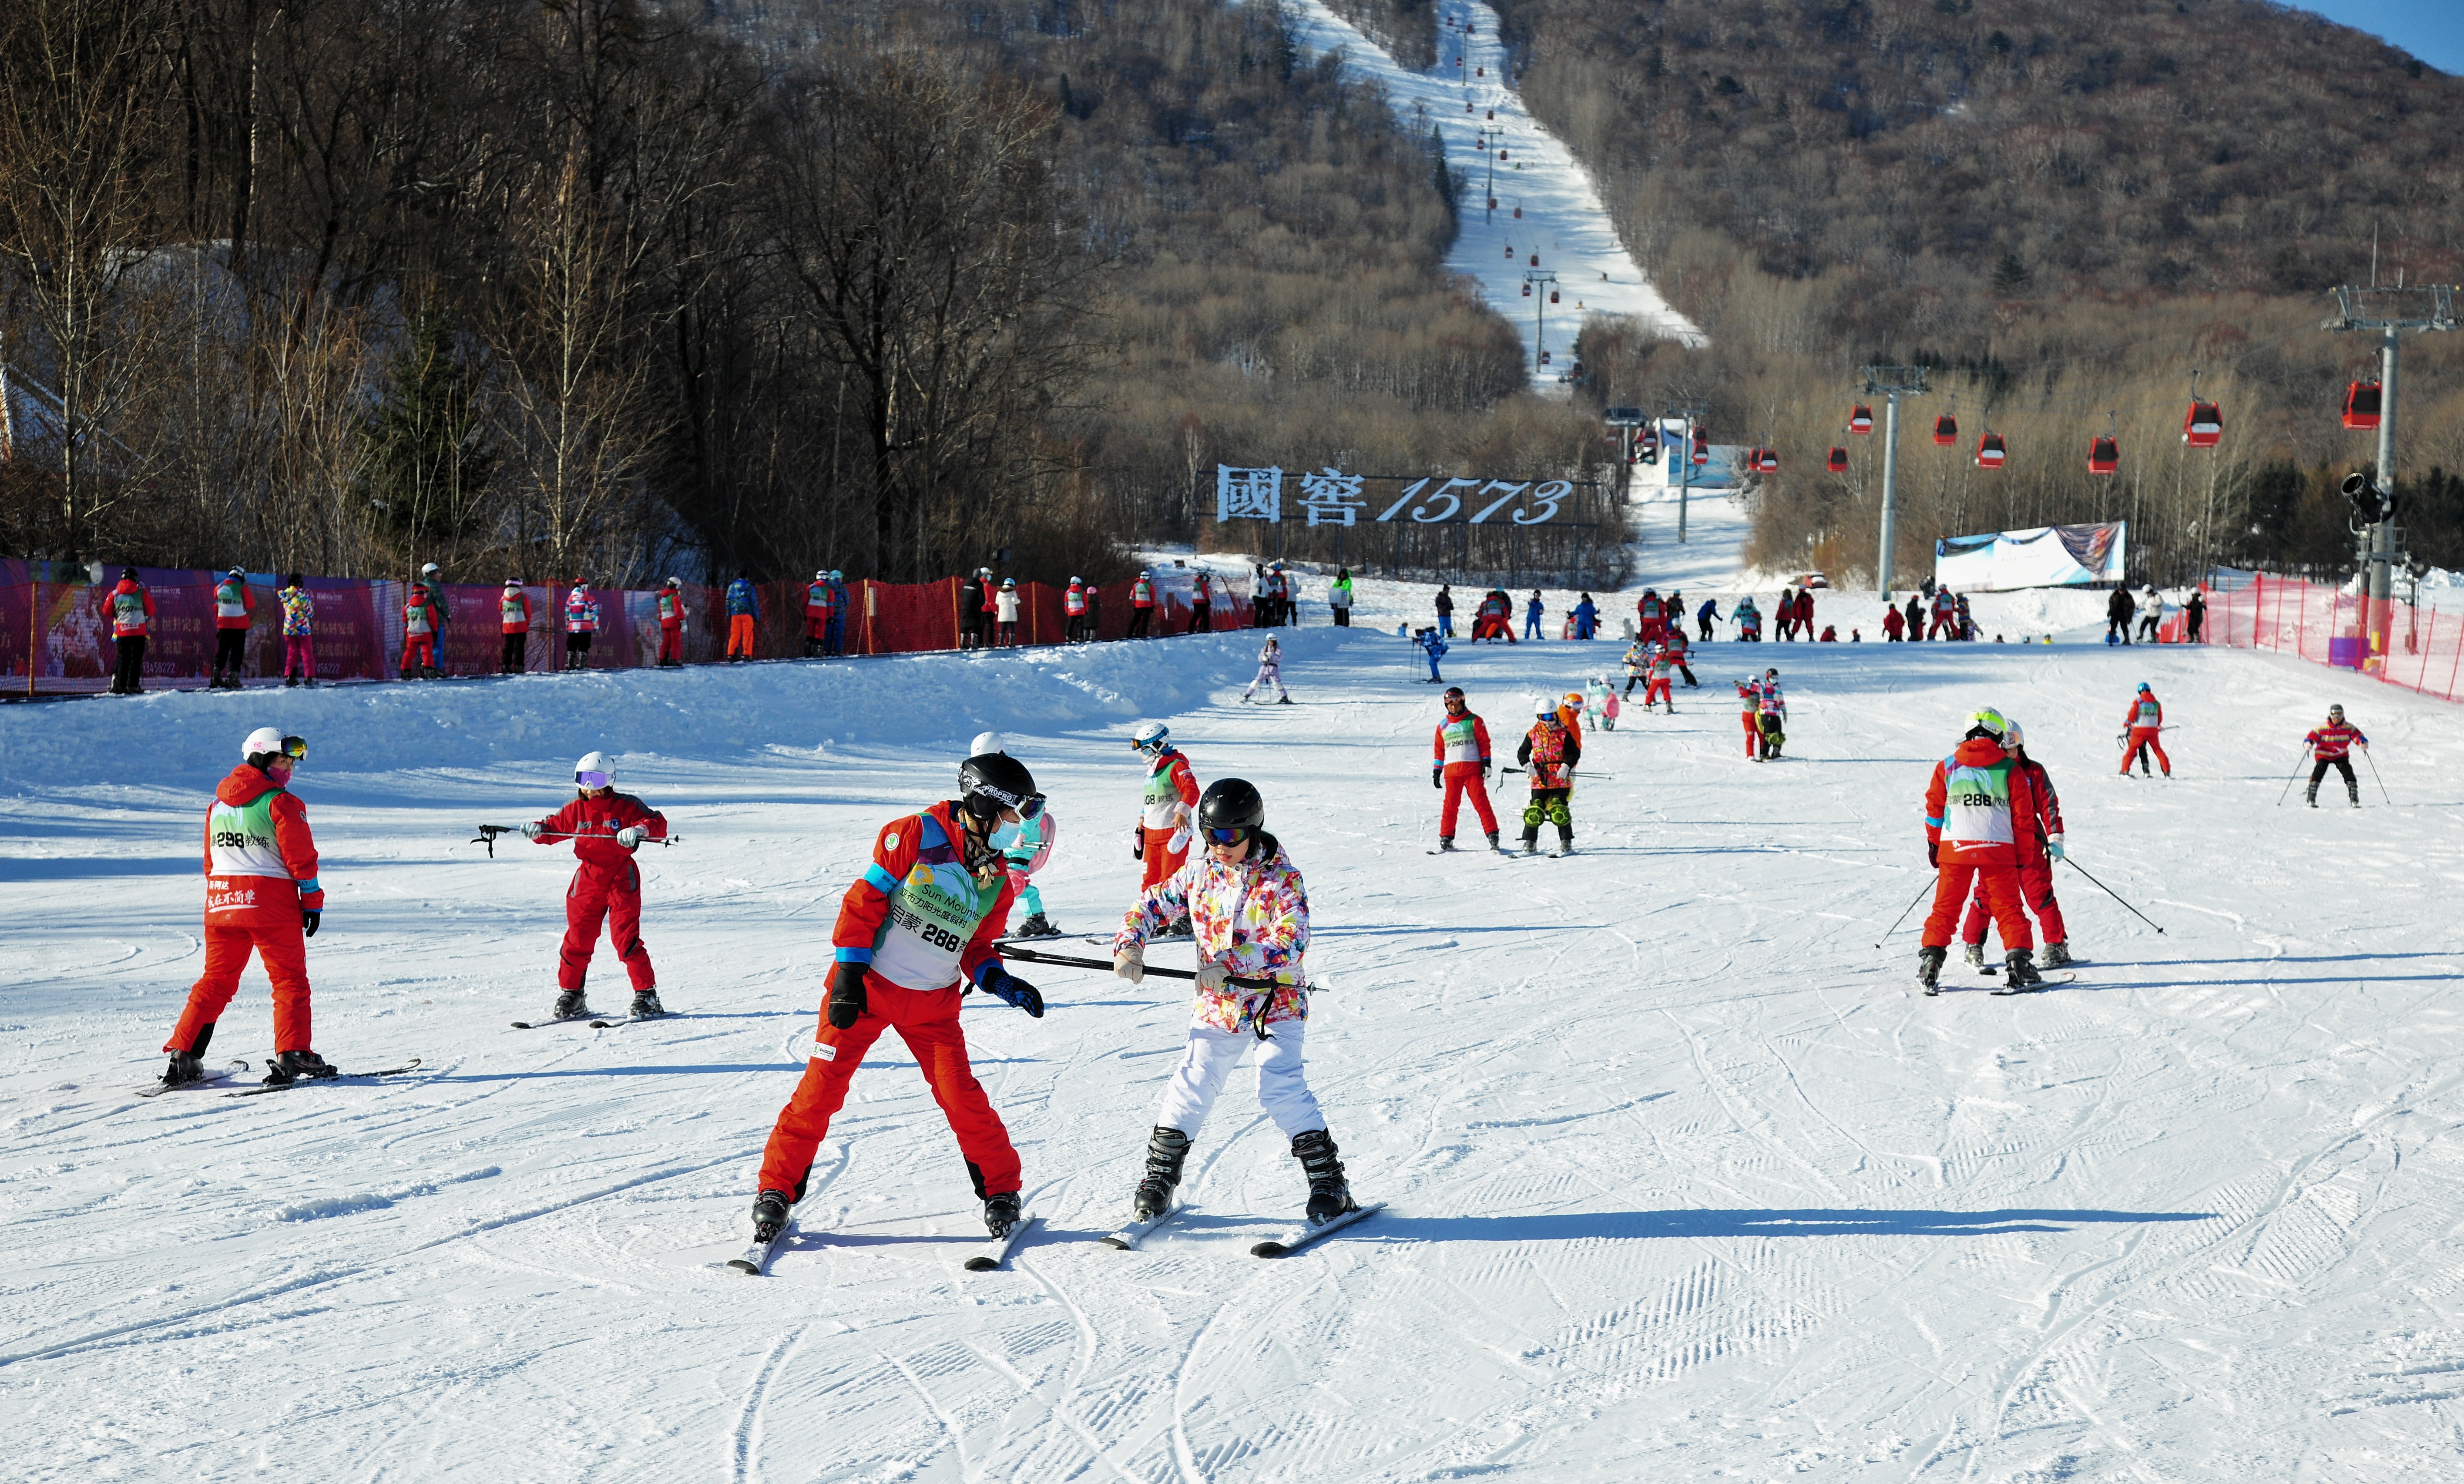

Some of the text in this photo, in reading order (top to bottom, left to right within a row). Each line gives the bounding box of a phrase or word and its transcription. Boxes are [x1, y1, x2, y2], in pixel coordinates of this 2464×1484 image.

[1376, 477, 1573, 525] 1573
[984, 786, 1012, 801] PROPRO
[1145, 794, 1155, 805] 08
[217, 831, 245, 848] 298
[245, 834, 269, 848] 教练
[922, 884, 942, 902] Sun
[900, 888, 967, 929] 亚布力阳光度假村
[890, 904, 923, 933] 启蒙
[921, 923, 960, 953] 288
